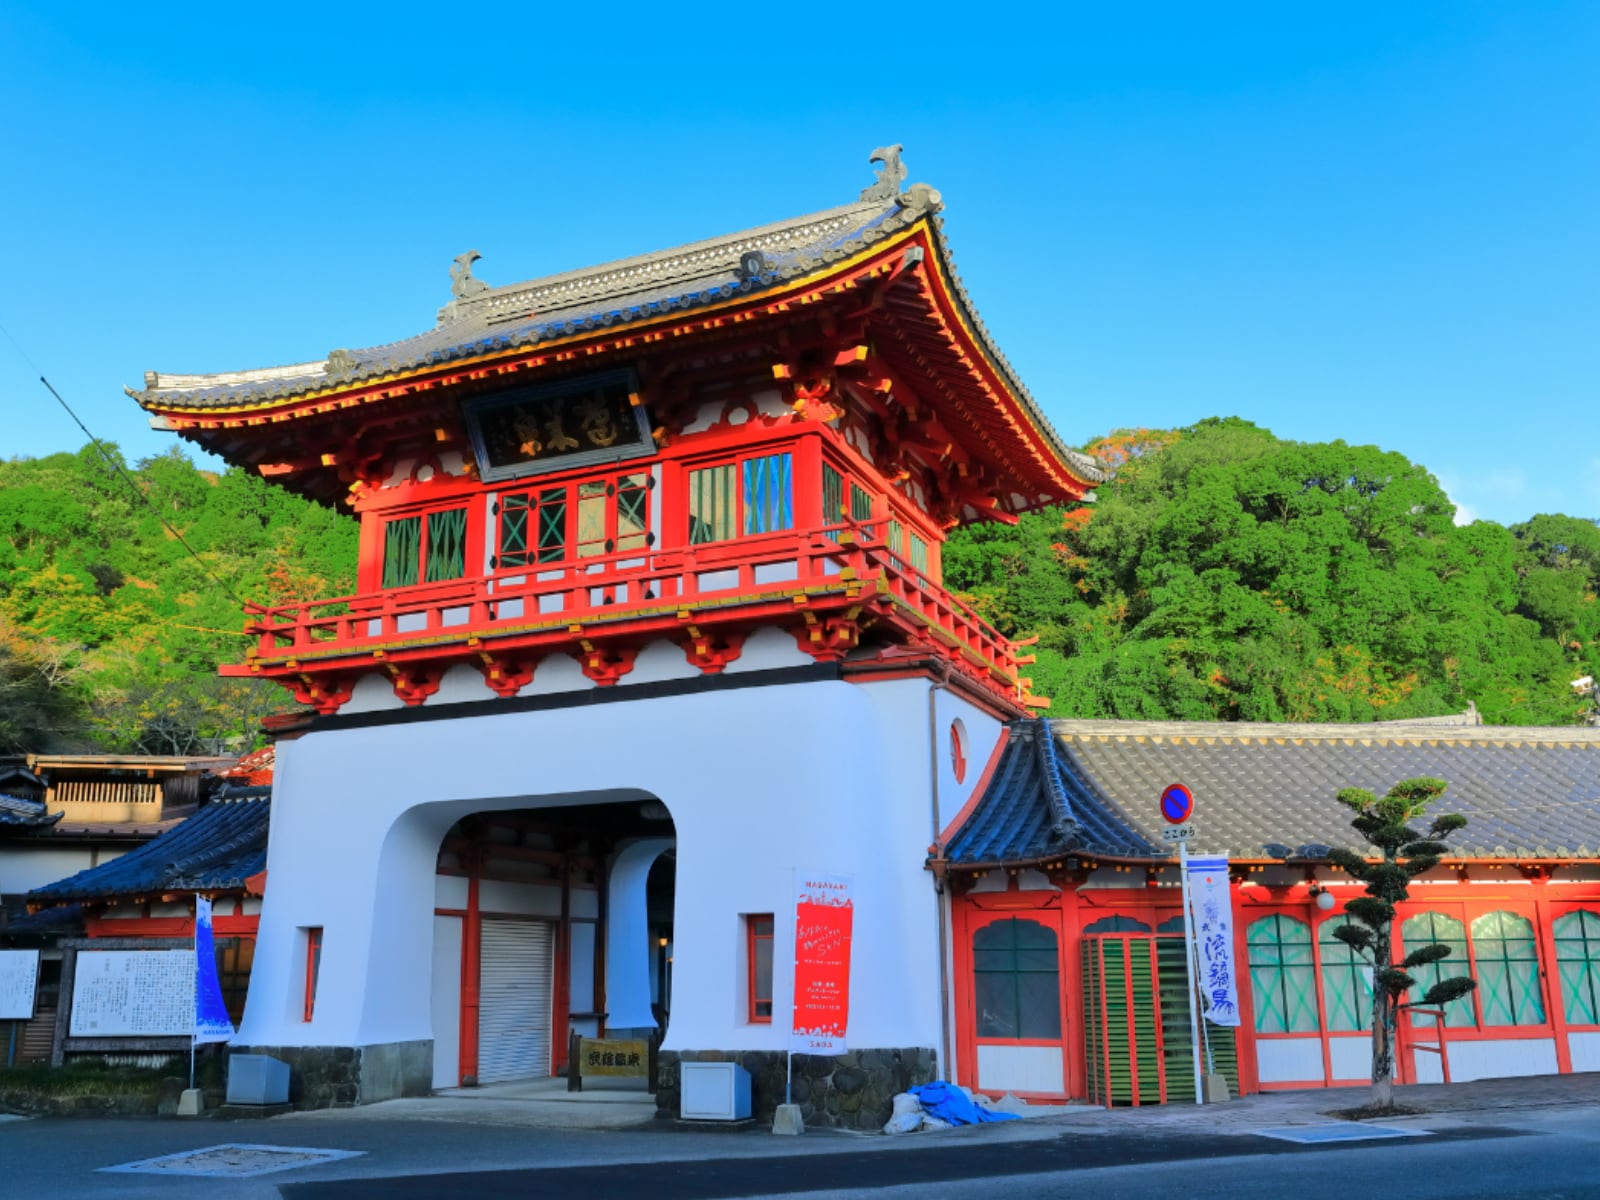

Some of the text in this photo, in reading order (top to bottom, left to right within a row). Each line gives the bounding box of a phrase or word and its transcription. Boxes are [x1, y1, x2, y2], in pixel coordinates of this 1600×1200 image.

[1163, 826, 1195, 840] ここから
[1205, 933, 1235, 1014] 流鏑馬
[810, 1040, 833, 1049] SAGA
